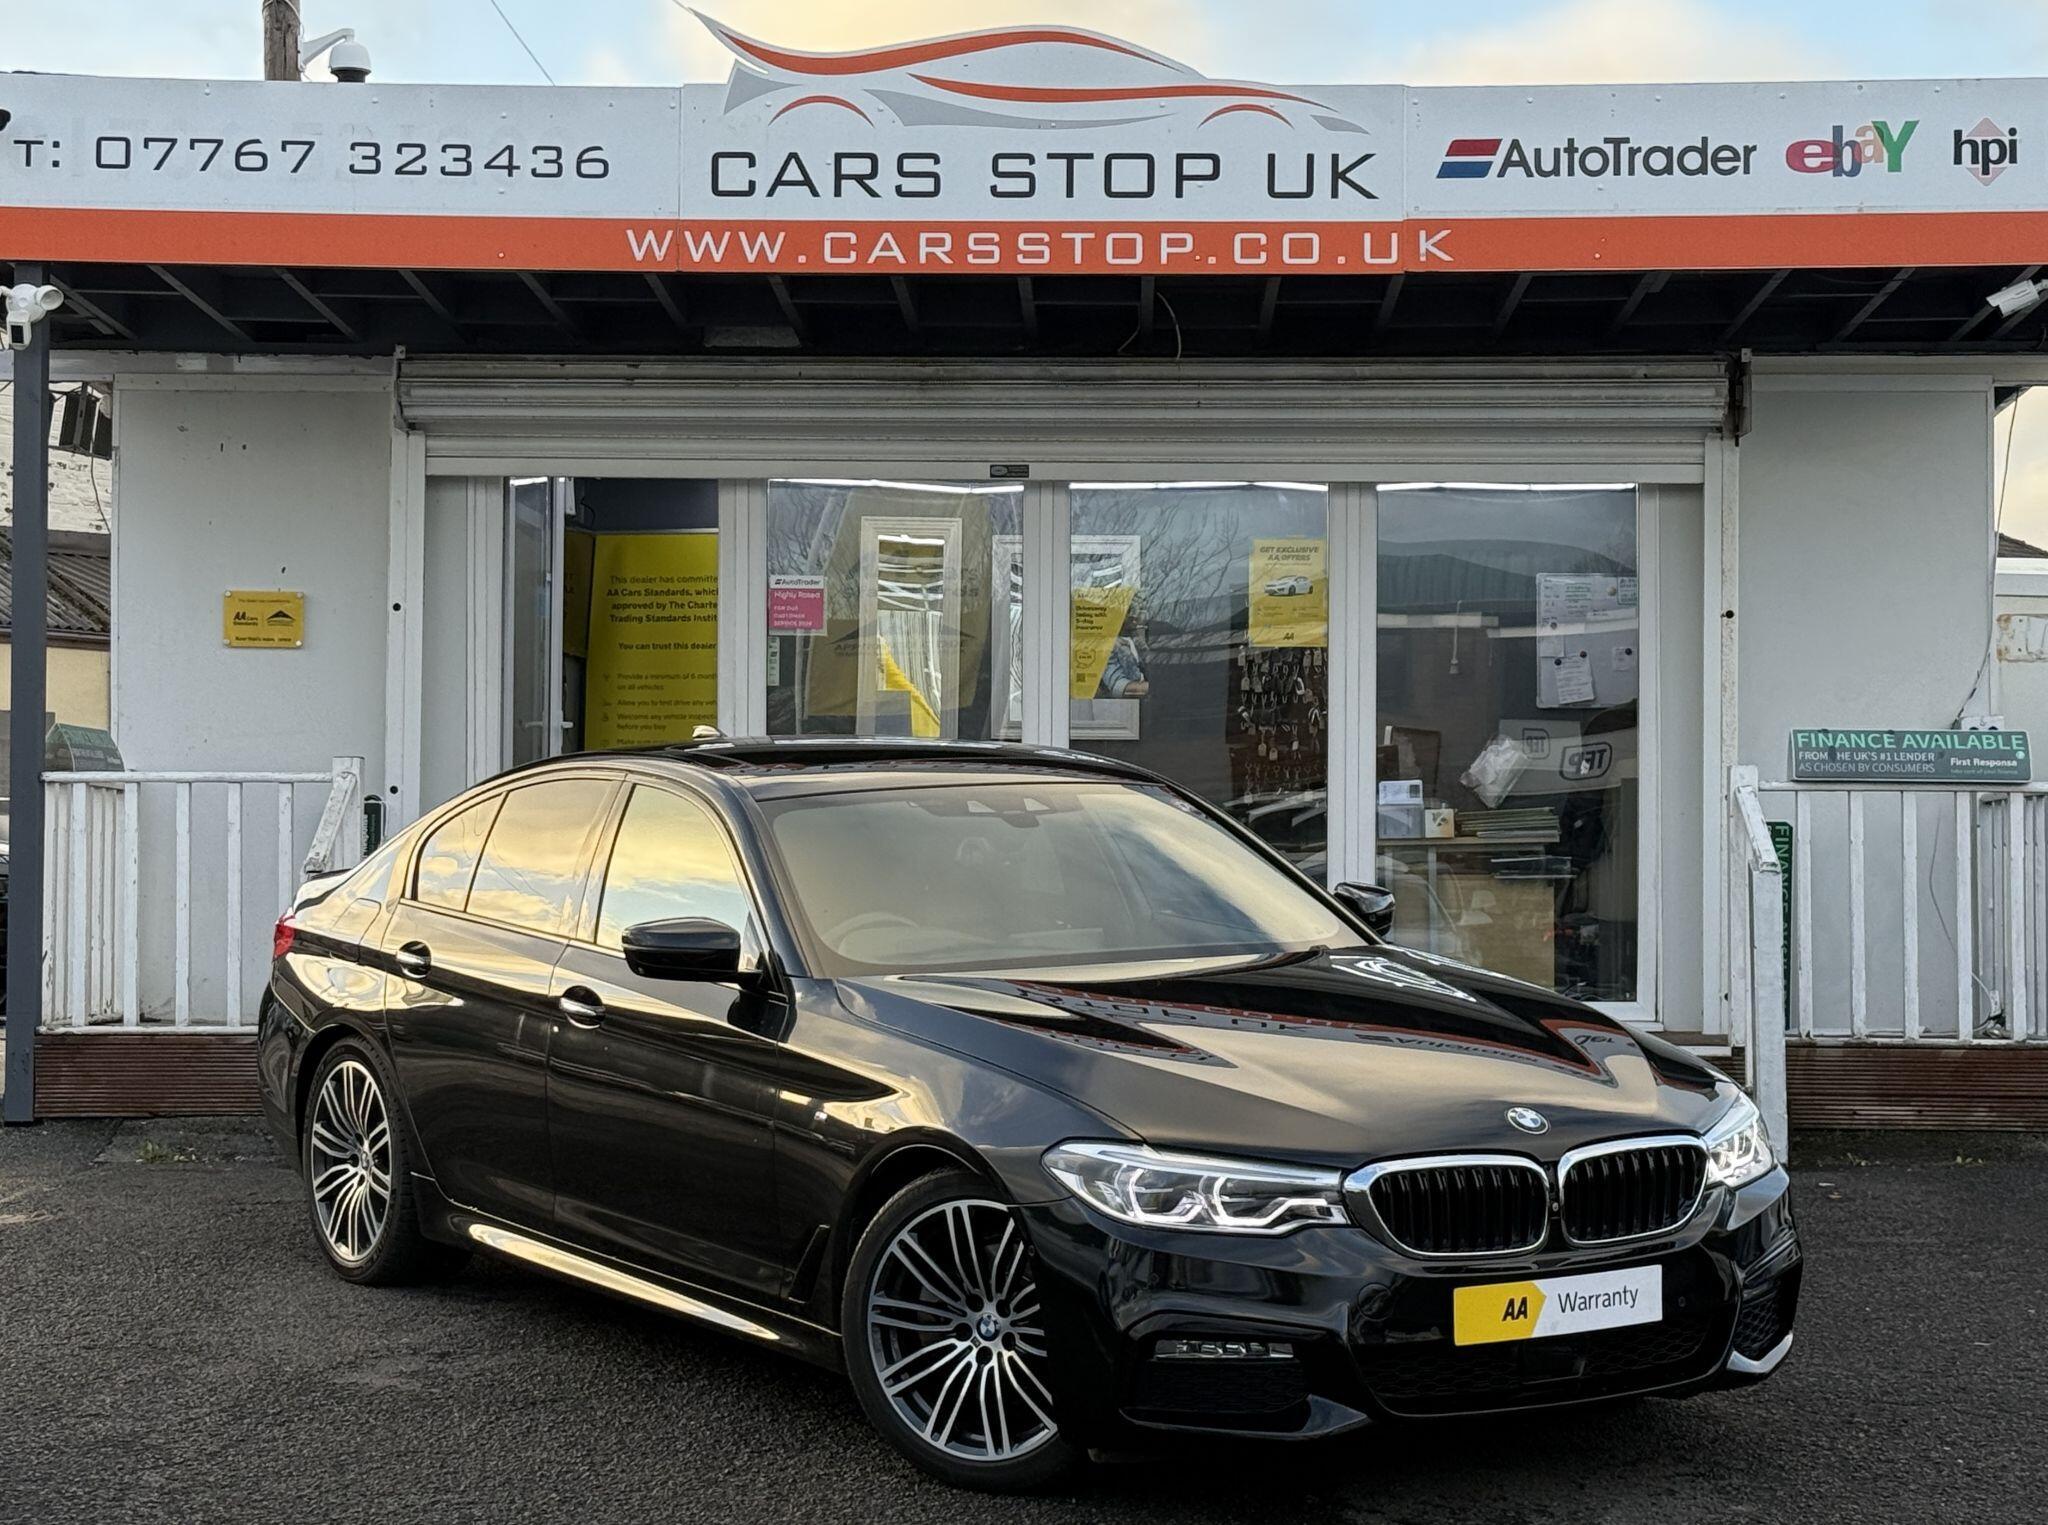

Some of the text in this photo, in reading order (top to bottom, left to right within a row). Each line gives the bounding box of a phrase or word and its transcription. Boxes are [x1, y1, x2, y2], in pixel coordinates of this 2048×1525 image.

[14, 136, 610, 179] T: 07767 323436
[1498, 137, 1757, 178] AutoTrader
[1953, 128, 2019, 176] hpi
[711, 152, 1379, 200] CARS STOP UK
[626, 228, 1454, 267] WWW.CARSSTOP.CO.UK
[621, 588, 642, 596] Cars
[612, 602, 653, 610] approved
[656, 601, 666, 610] by
[670, 601, 685, 609] The
[610, 615, 642, 624] Trading
[646, 614, 691, 622] Standards
[619, 642, 633, 650] You
[652, 642, 671, 650] trust
[674, 642, 689, 650] this
[1797, 733, 2025, 750] FINANCE AVAILABLE
[1799, 752, 1828, 761] FROM
[1830, 752, 1851, 761] HE
[1853, 752, 1877, 761] UK'S
[1894, 752, 1935, 762] LENDER
[1951, 758, 1970, 767] First
[1799, 763, 1935, 773] AS CHOSEN BY CONSUMERS
[1502, 1285, 1639, 1321] AA Warranty
